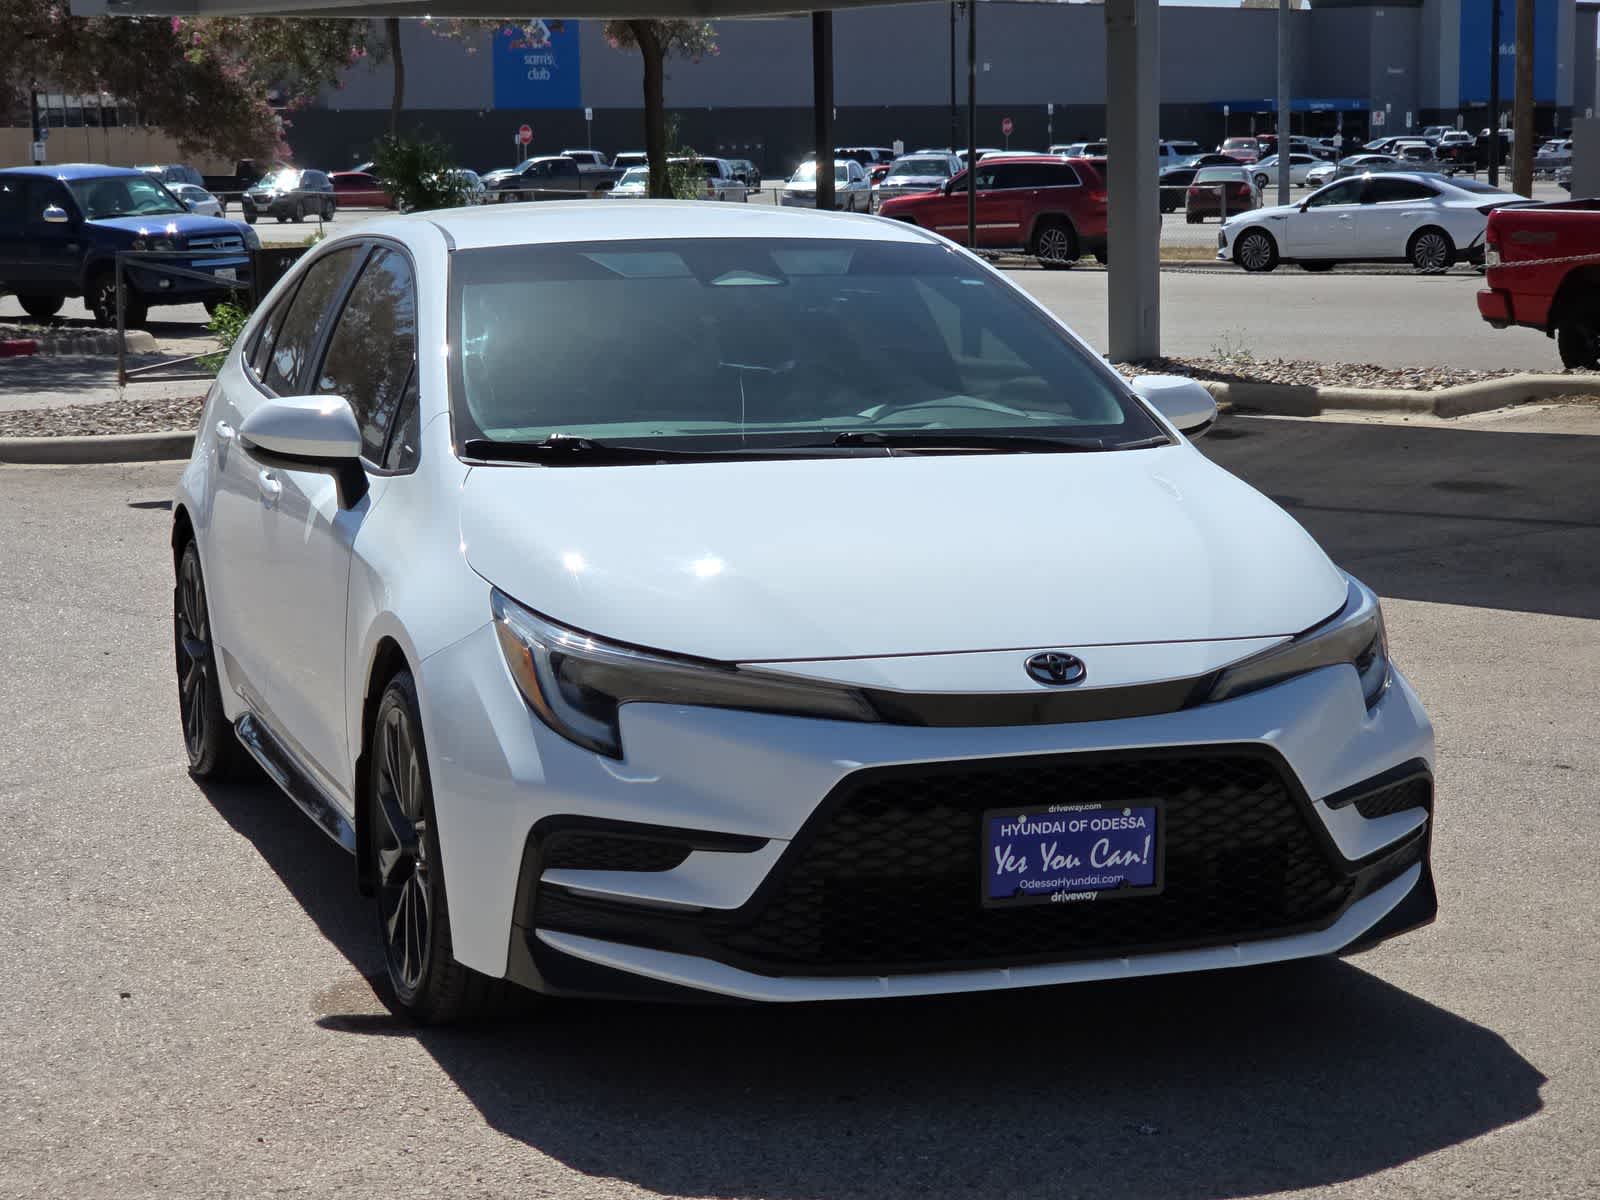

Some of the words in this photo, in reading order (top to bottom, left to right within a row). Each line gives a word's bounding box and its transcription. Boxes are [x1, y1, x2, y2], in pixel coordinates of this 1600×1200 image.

[527, 67, 551, 80] club
[1048, 802, 1102, 814] driveway.com
[1001, 821, 1066, 837] HYUNDAI
[1069, 819, 1088, 833] OF
[1090, 816, 1146, 831] ODESSA
[994, 844, 1028, 875] Yes
[1040, 841, 1081, 872] You
[1090, 834, 1151, 868] Can!
[1020, 874, 1124, 889] OdessaHyundai.com
[1051, 889, 1098, 903] driveway
